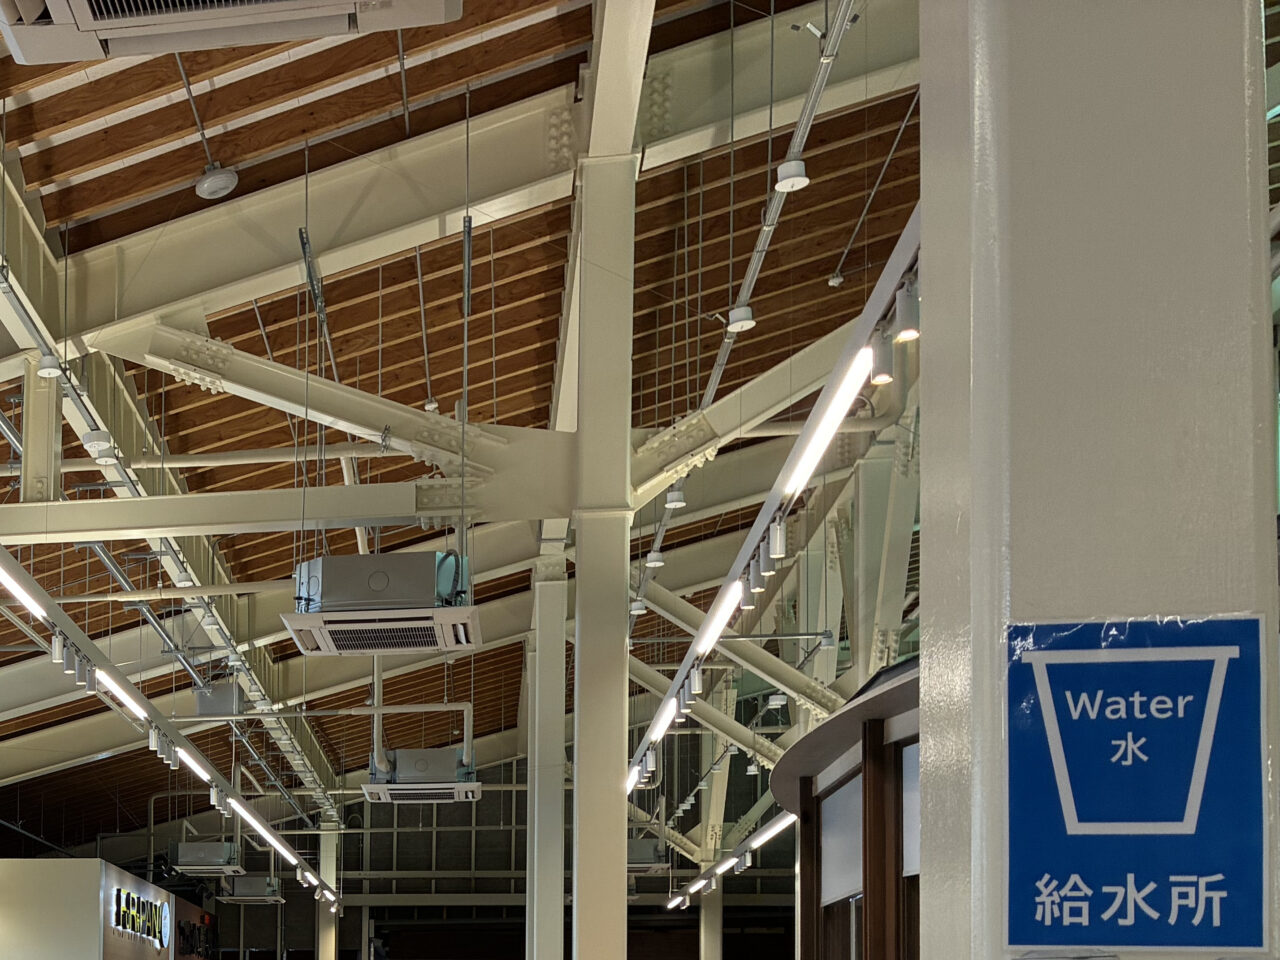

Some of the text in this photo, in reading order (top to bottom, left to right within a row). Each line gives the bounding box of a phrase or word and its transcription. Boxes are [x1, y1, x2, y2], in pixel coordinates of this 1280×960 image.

[1065, 690, 1195, 720] Water
[1110, 731, 1149, 766] 水
[1035, 872, 1228, 927] 給水所
